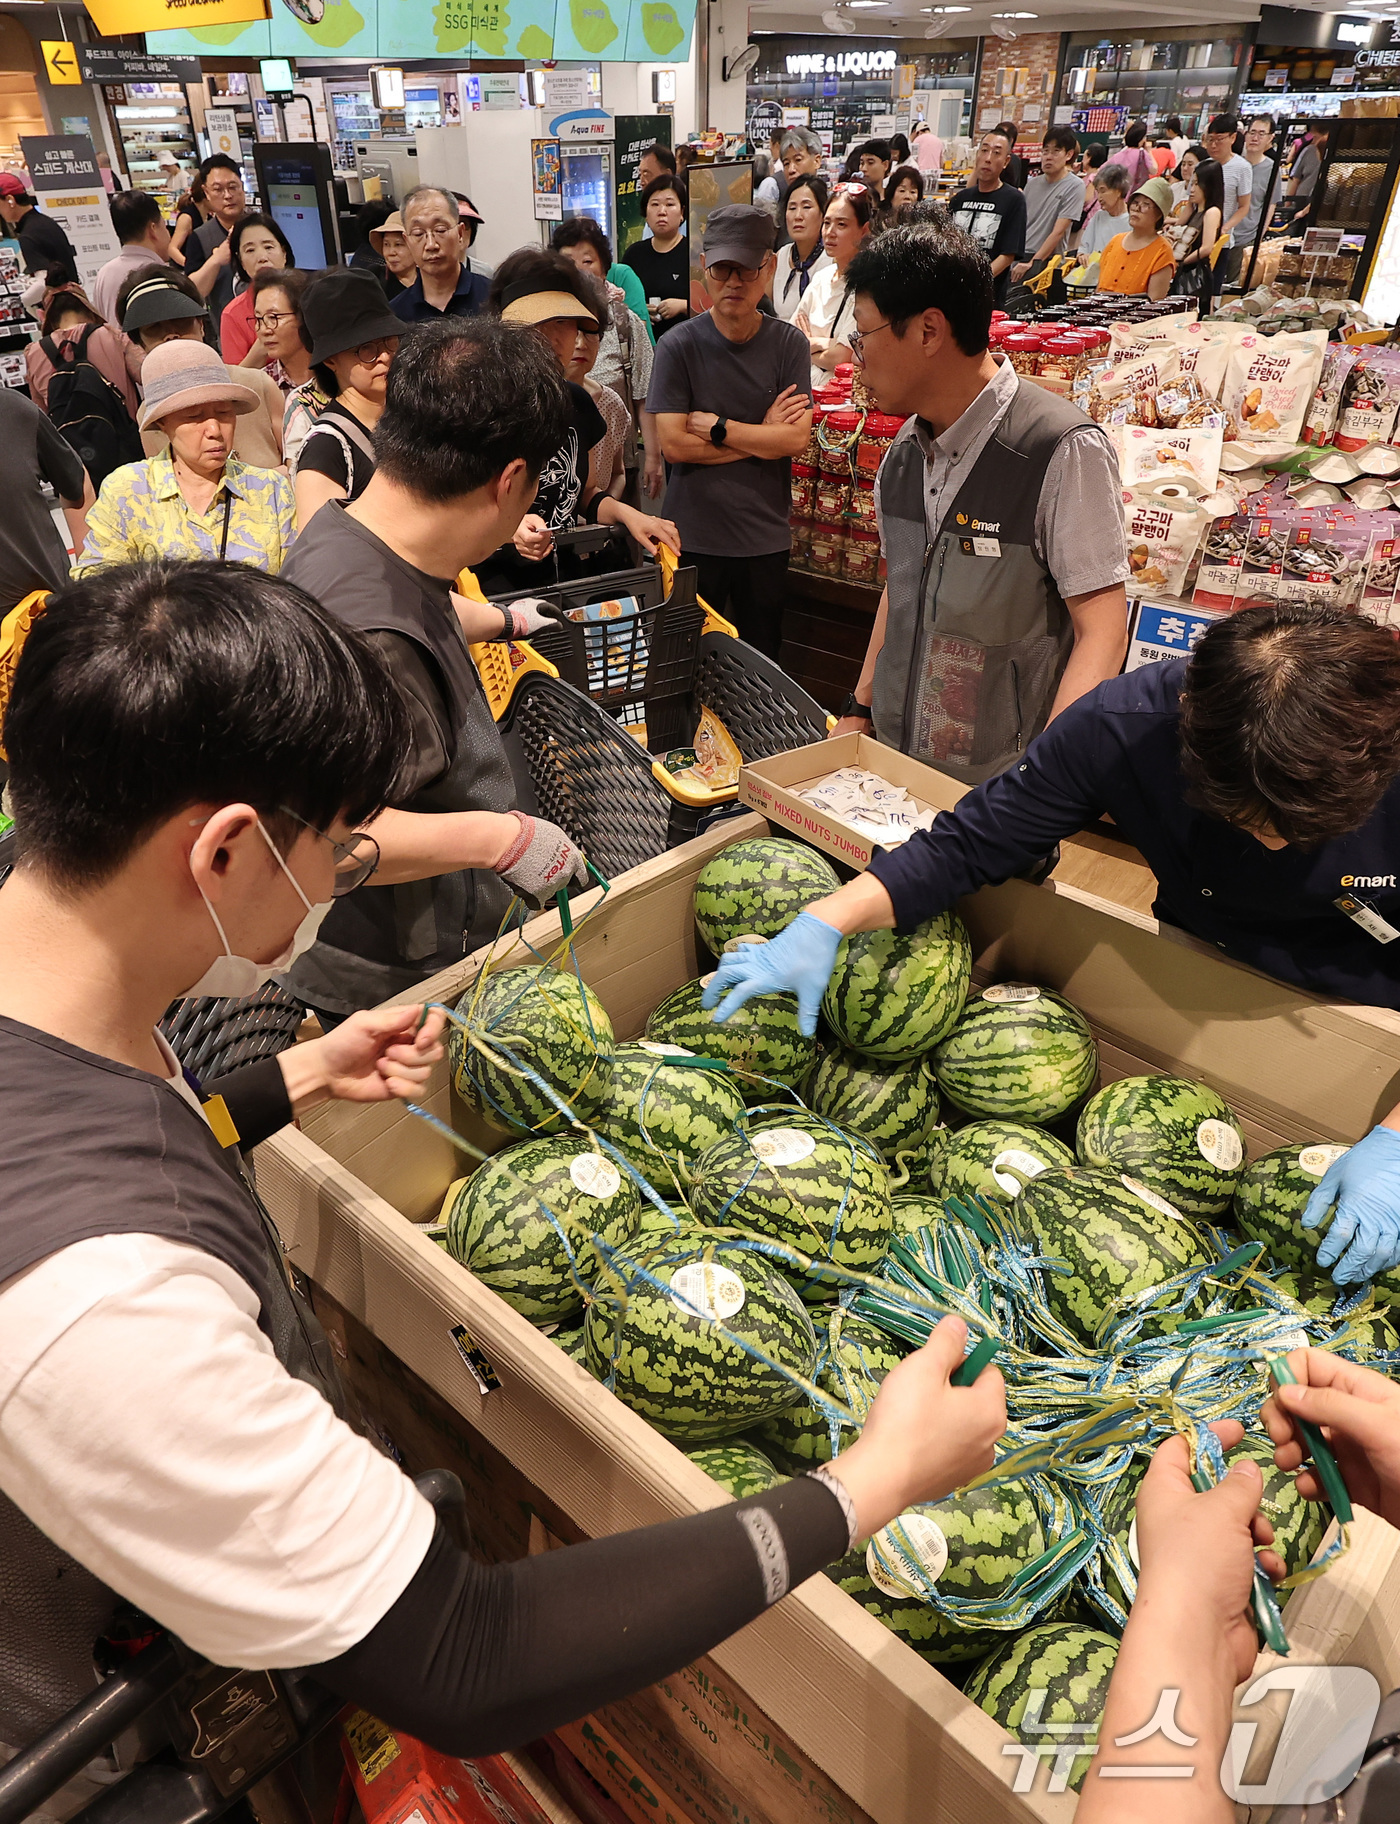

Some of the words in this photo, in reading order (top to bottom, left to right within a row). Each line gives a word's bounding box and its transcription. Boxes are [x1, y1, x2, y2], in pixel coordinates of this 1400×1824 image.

[445, 14, 468, 29] SSG
[471, 16, 498, 31] 미식관
[786, 53, 825, 74] WINE
[825, 56, 836, 72] &
[836, 50, 897, 75] LIQUOR
[590, 125, 605, 134] FINE
[755, 118, 777, 128] WINE
[34, 162, 64, 176] 스피드
[64, 160, 94, 174] 계산대
[962, 201, 996, 211] WANTED
[1252, 353, 1291, 368] 고구마
[1247, 366, 1286, 384] 말랭이
[971, 518, 1001, 533] emart
[1133, 508, 1173, 527] 고구마
[1131, 522, 1170, 542] 말랭이
[1140, 647, 1159, 661] 동원
[774, 800, 803, 826] MIXED
[804, 817, 832, 843] NUTS
[833, 832, 868, 863] JUMBO
[1340, 874, 1397, 888] emart
[580, 1720, 660, 1810] KCP
